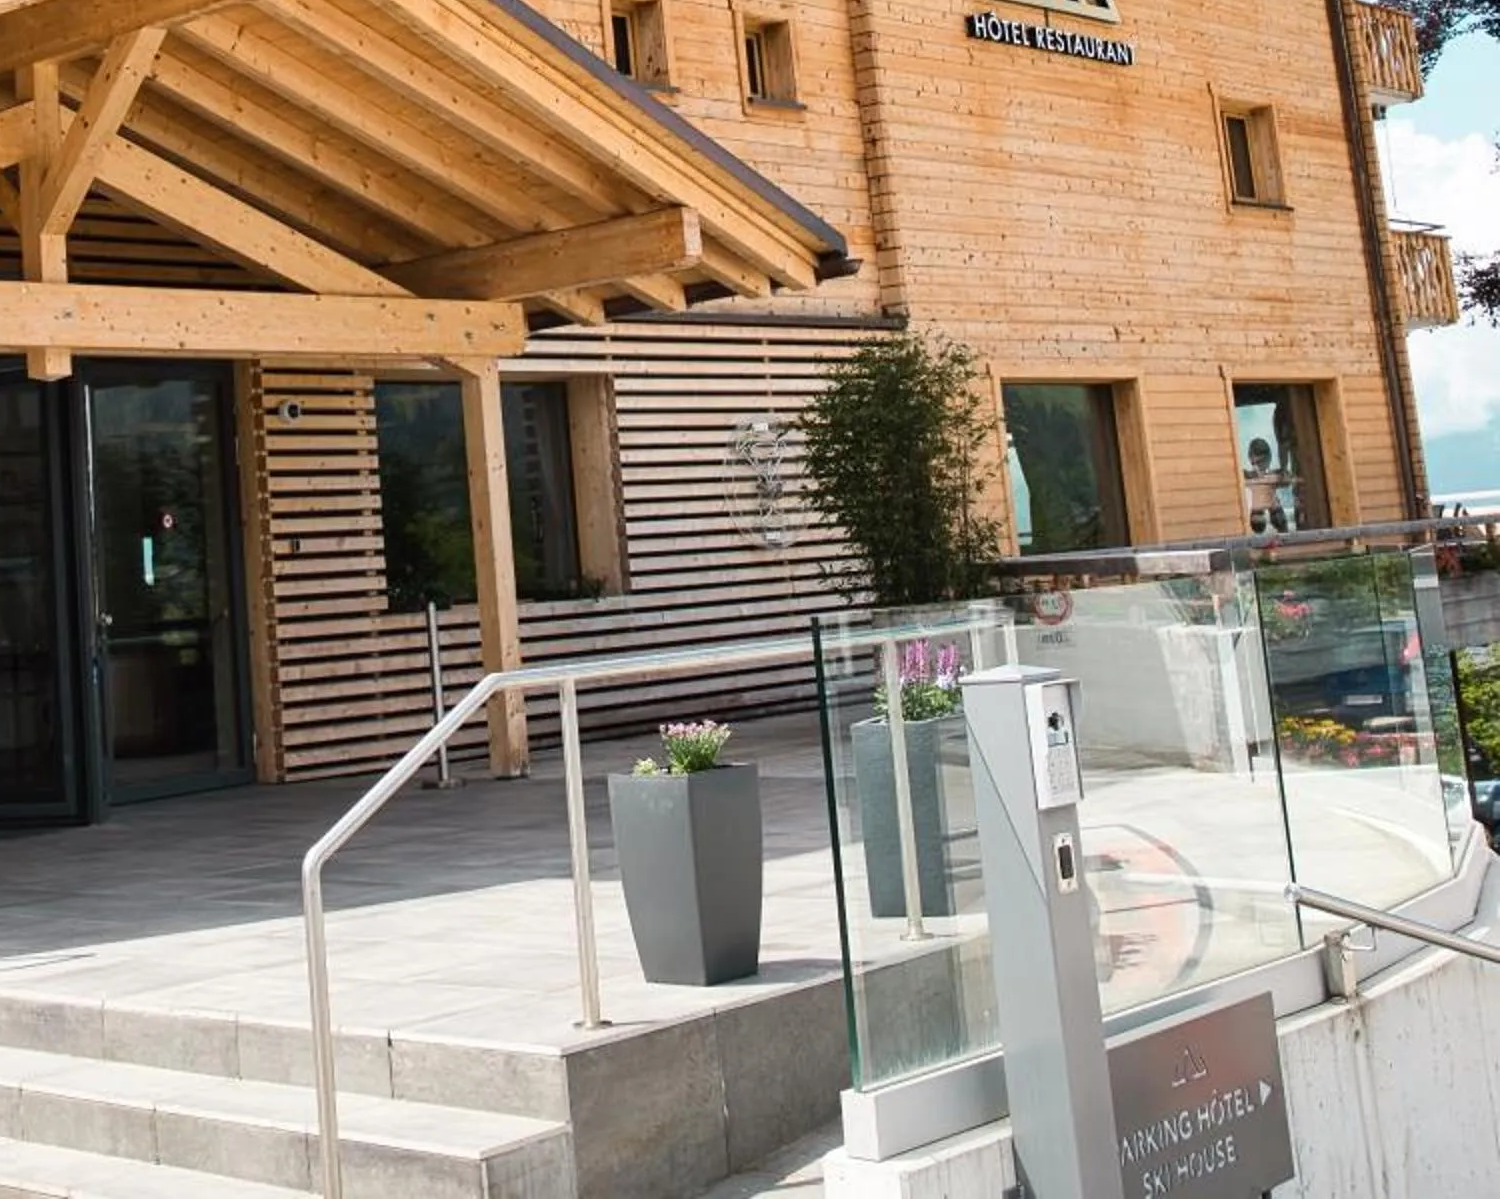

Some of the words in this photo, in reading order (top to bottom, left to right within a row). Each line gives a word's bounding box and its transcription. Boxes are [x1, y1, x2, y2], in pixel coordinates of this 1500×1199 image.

[973, 10, 1031, 46] HÔTEL
[1035, 25, 1137, 66] RESTAURANT
[1120, 1110, 1193, 1167] ARKING
[1197, 1087, 1255, 1133] HÔTEL
[1143, 1163, 1171, 1199] SKI
[1177, 1135, 1237, 1181] HOUSE
